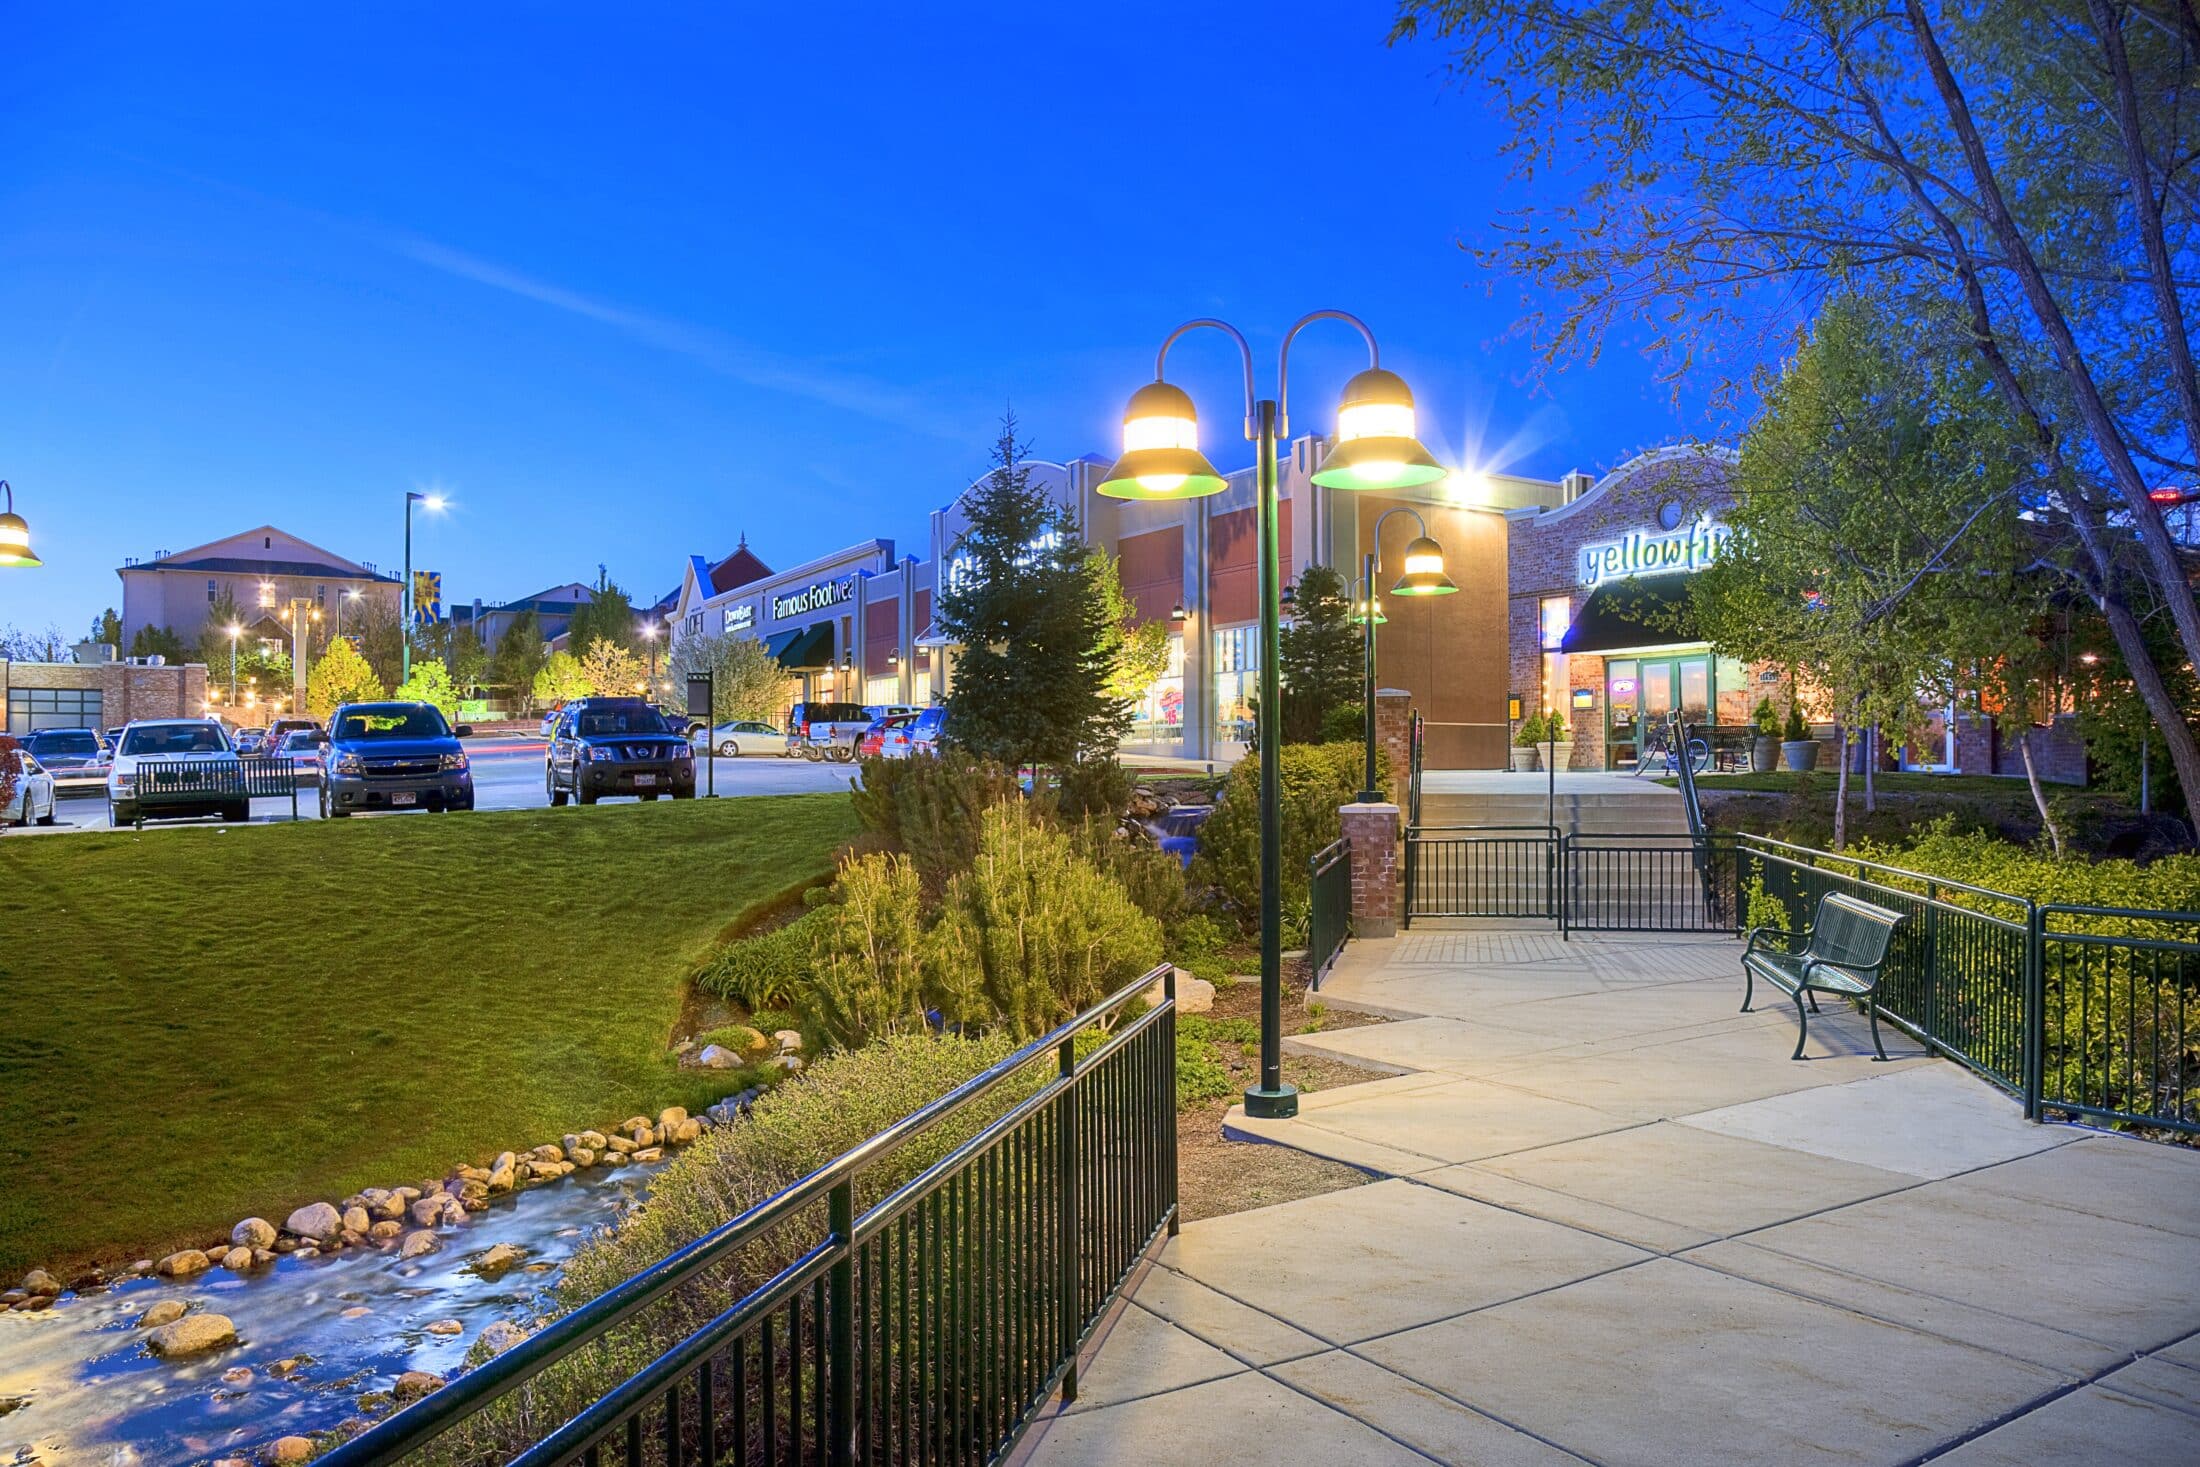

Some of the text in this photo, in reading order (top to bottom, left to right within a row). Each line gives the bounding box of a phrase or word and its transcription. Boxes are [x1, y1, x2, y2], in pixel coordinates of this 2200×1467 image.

[1585, 519, 1746, 585] yellowfin
[773, 579, 853, 620] Famous Footwea
